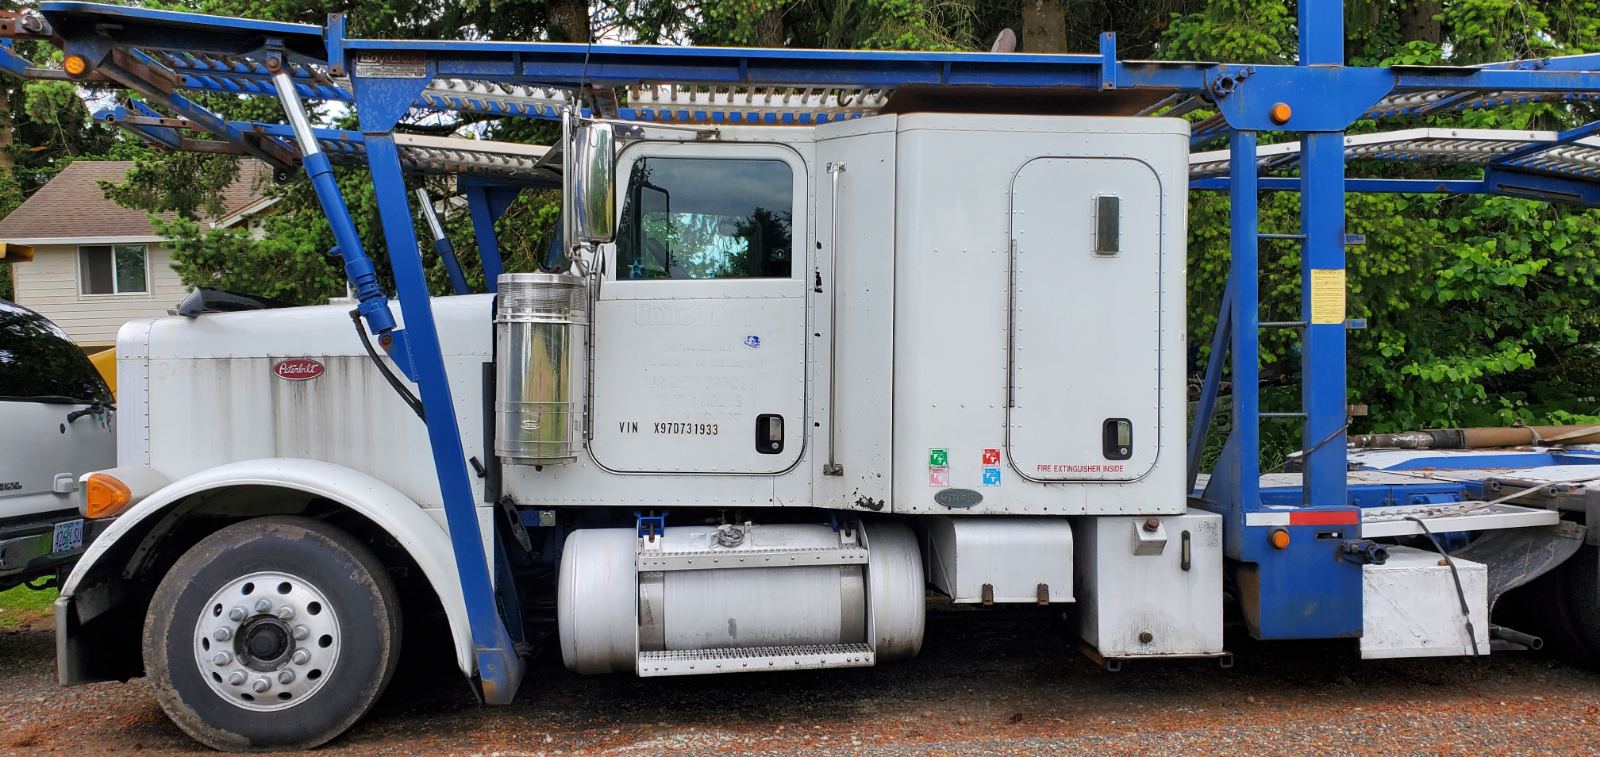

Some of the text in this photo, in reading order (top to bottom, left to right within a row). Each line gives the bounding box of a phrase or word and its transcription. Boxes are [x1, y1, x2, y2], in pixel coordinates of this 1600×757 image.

[279, 362, 319, 375] Peterbilt
[619, 421, 638, 434] VIN
[1036, 464, 1124, 473] FIRE EXTINGUISHER INSIDE
